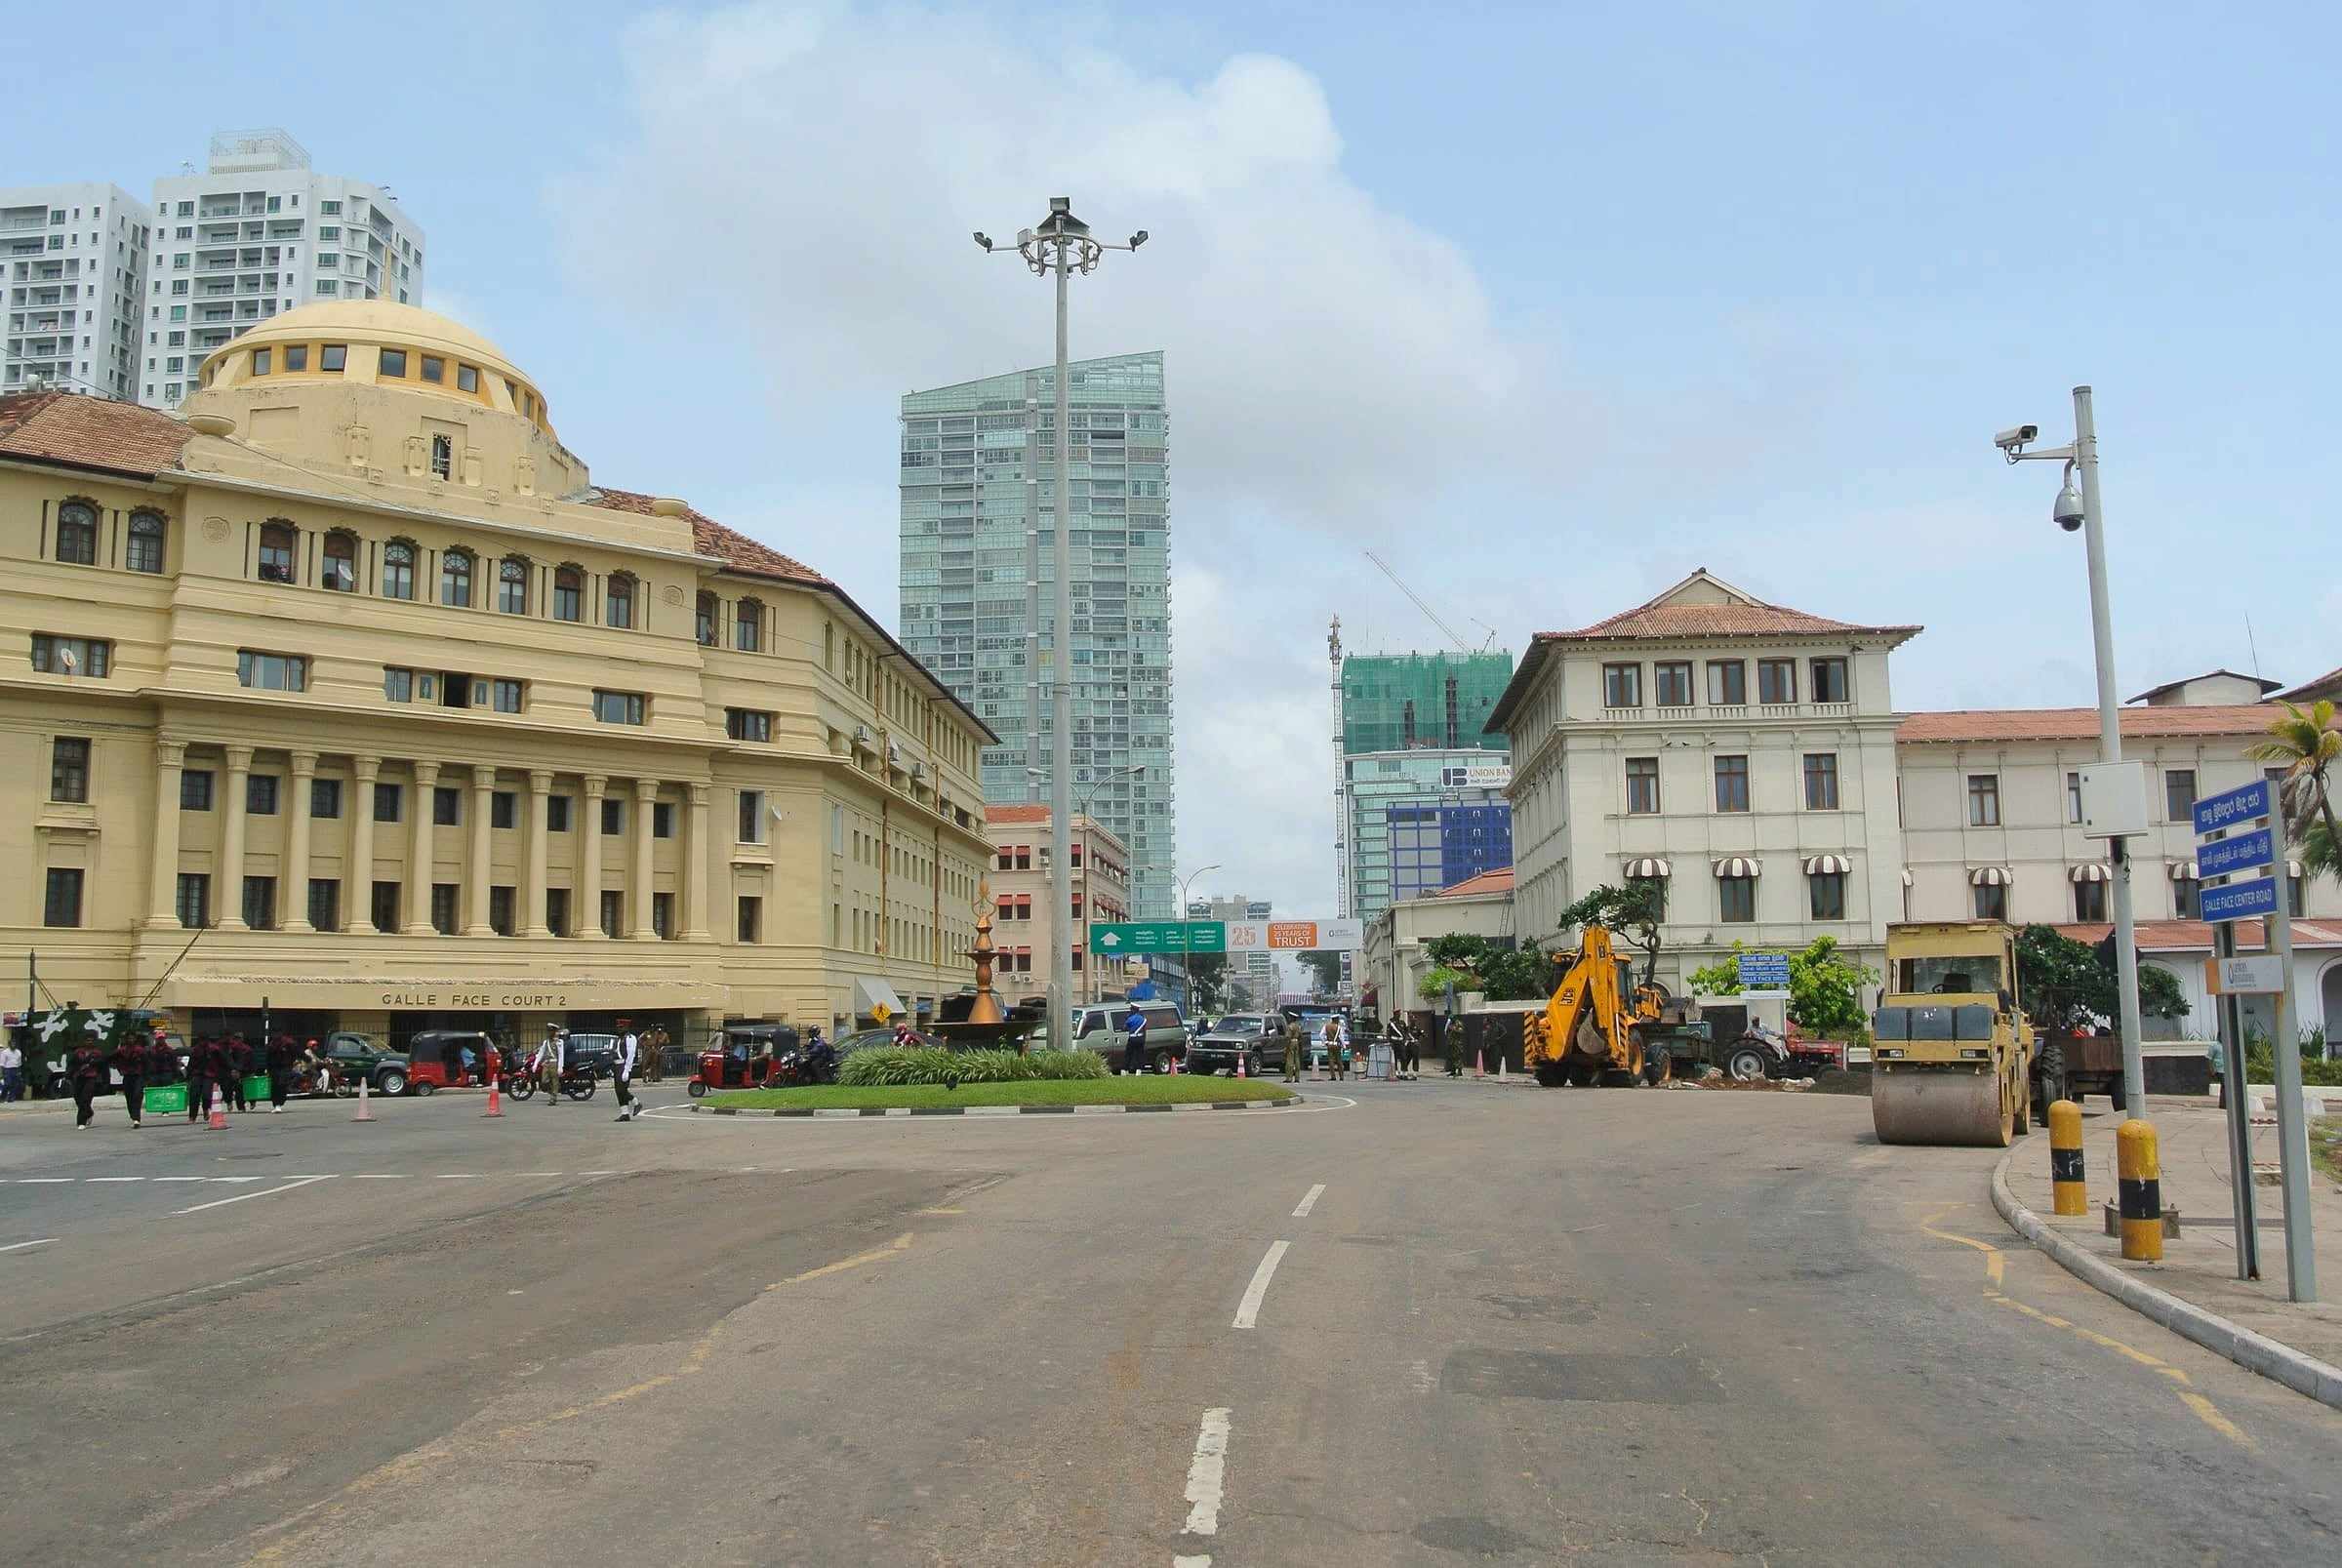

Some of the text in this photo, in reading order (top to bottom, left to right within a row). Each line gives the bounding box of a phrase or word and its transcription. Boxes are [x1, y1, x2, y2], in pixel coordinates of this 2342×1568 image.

[1469, 768, 1514, 777] UNION BAN
[2205, 889, 2272, 911] GALLE FACE CENTER ROAD
[1232, 926, 1257, 946] 25
[1274, 937, 1312, 946] TRUST
[382, 993, 567, 1006] GALLE FACE COURT 2
